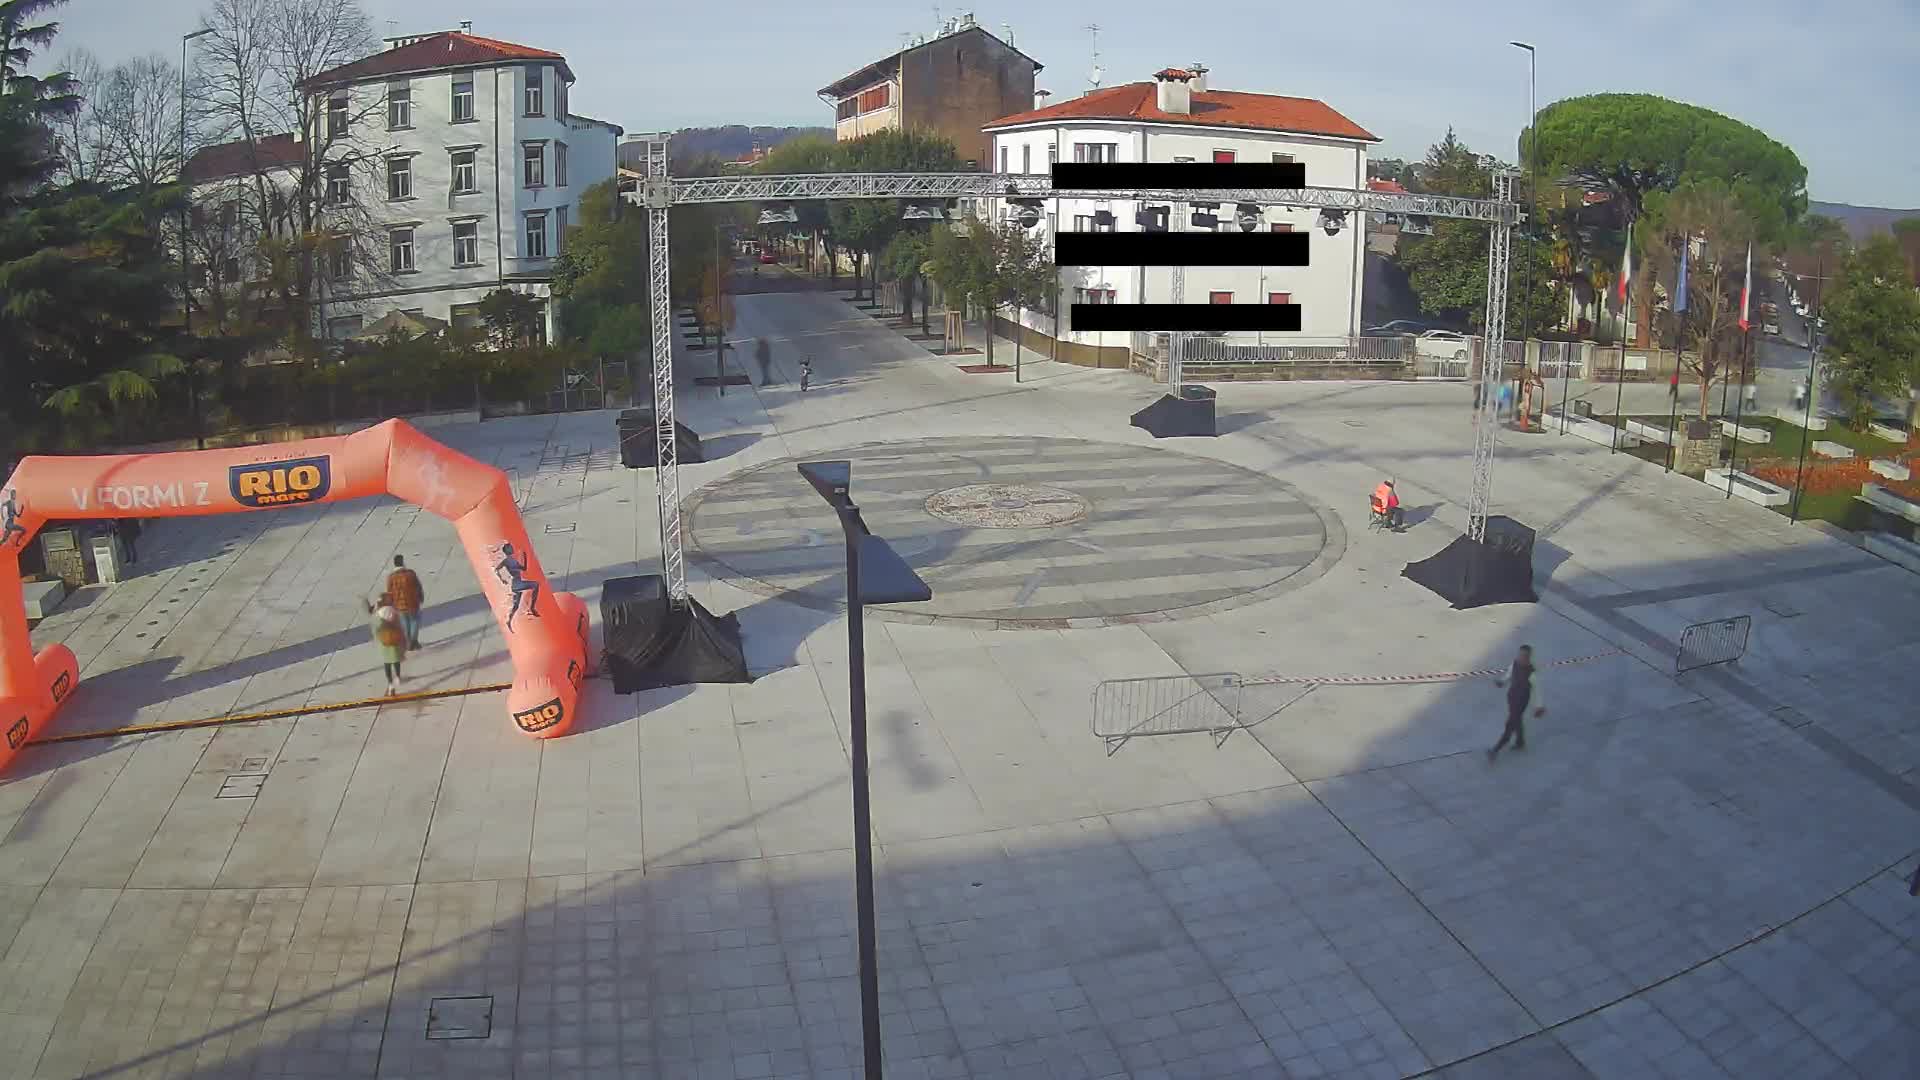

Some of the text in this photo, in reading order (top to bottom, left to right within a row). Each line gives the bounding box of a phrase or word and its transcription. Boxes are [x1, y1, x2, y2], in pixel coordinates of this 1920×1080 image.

[239, 465, 321, 497] RIO
[71, 480, 212, 511] V FORMI Z
[257, 491, 310, 504] mare
[518, 704, 560, 728] RIO
